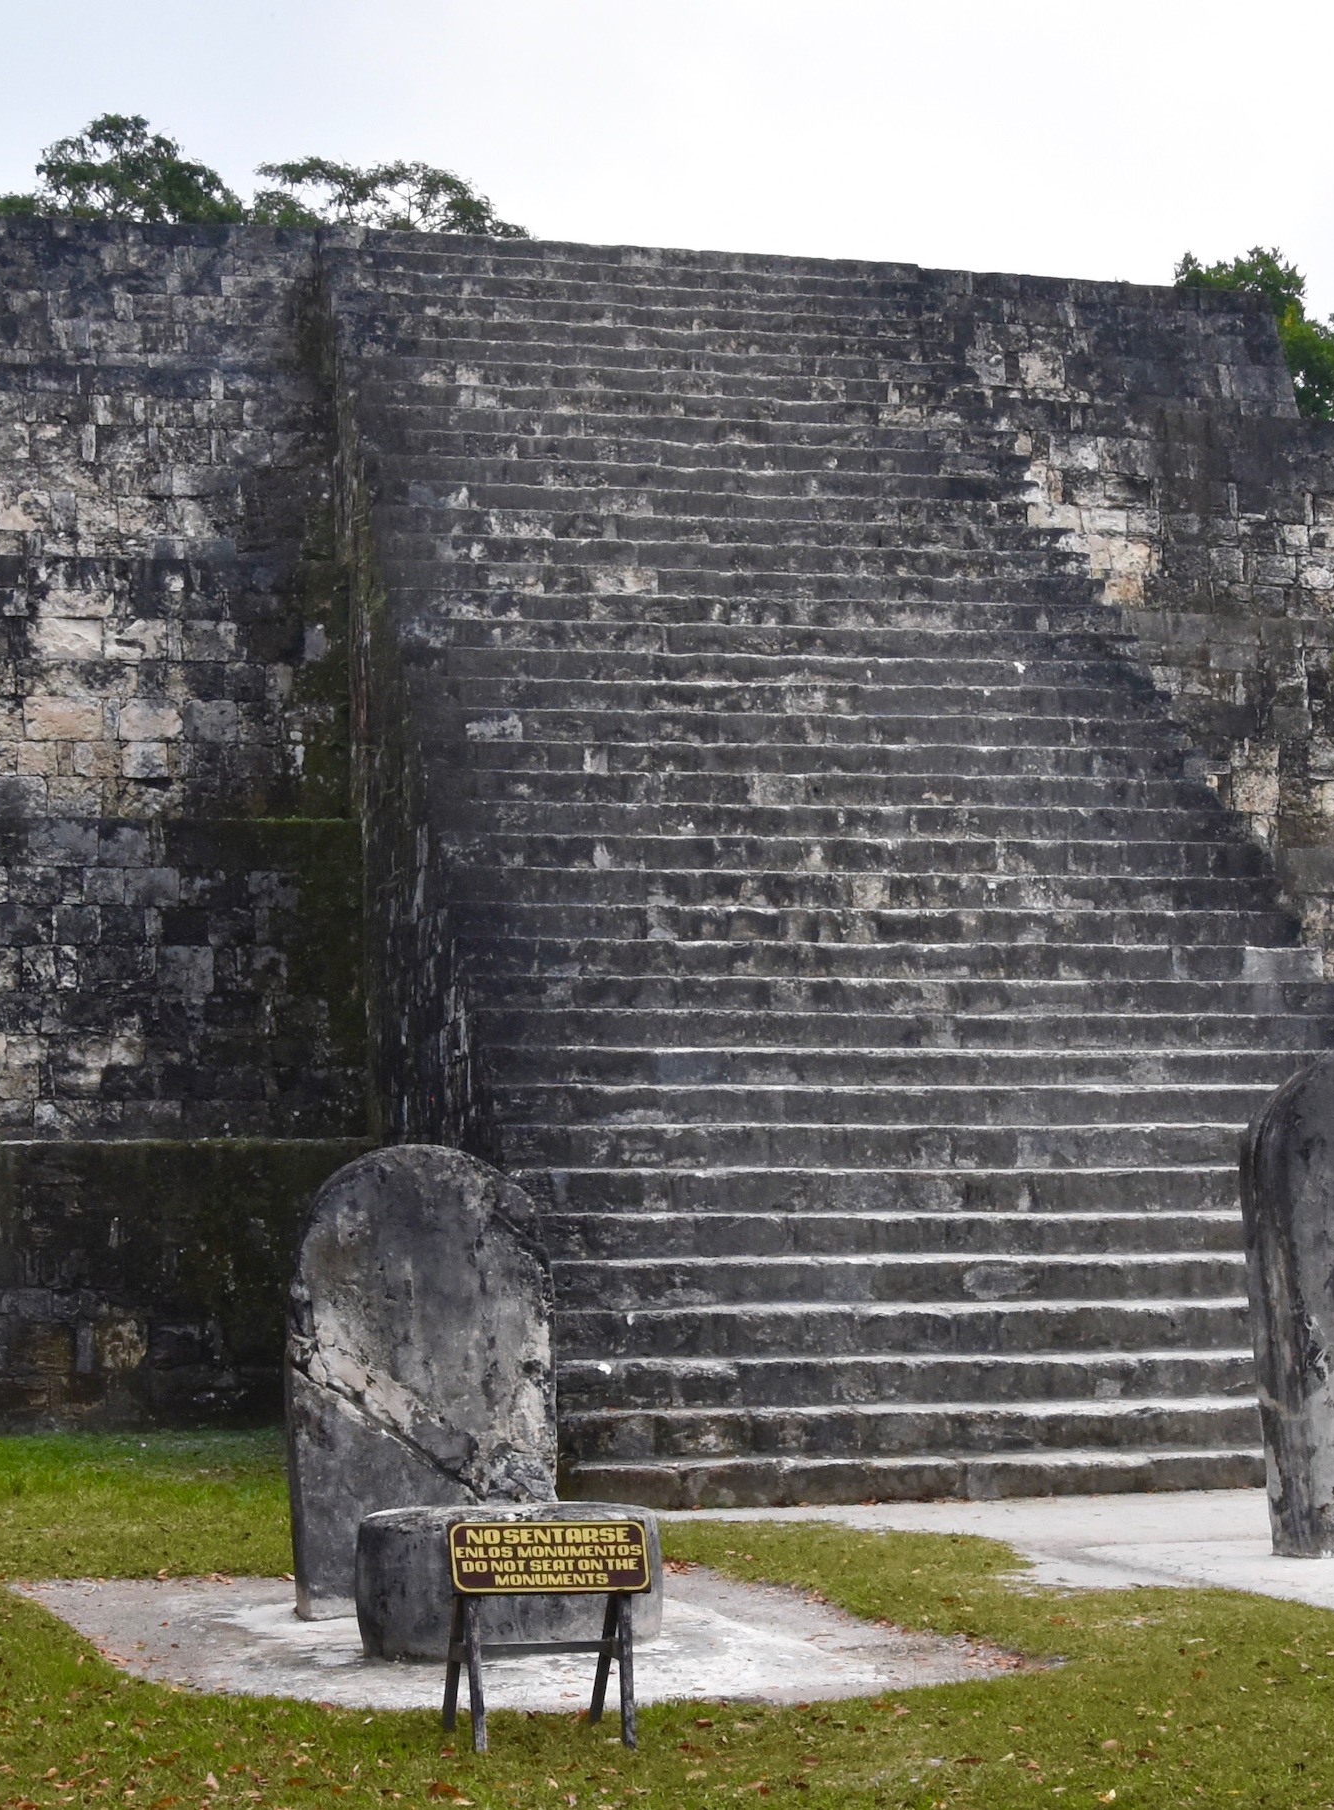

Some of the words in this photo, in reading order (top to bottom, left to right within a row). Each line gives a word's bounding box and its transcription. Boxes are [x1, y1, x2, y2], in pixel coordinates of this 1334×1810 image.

[466, 1529, 500, 1544] NO
[503, 1527, 630, 1544] SENTARSE
[517, 1544, 642, 1558] MONUMENTOS
[461, 1560, 488, 1572] DO
[490, 1560, 525, 1572] NOT
[529, 1559, 575, 1572] SEAT
[577, 1559, 603, 1570] ON
[605, 1558, 639, 1570] THE
[494, 1573, 609, 1586] MONUMENTS
